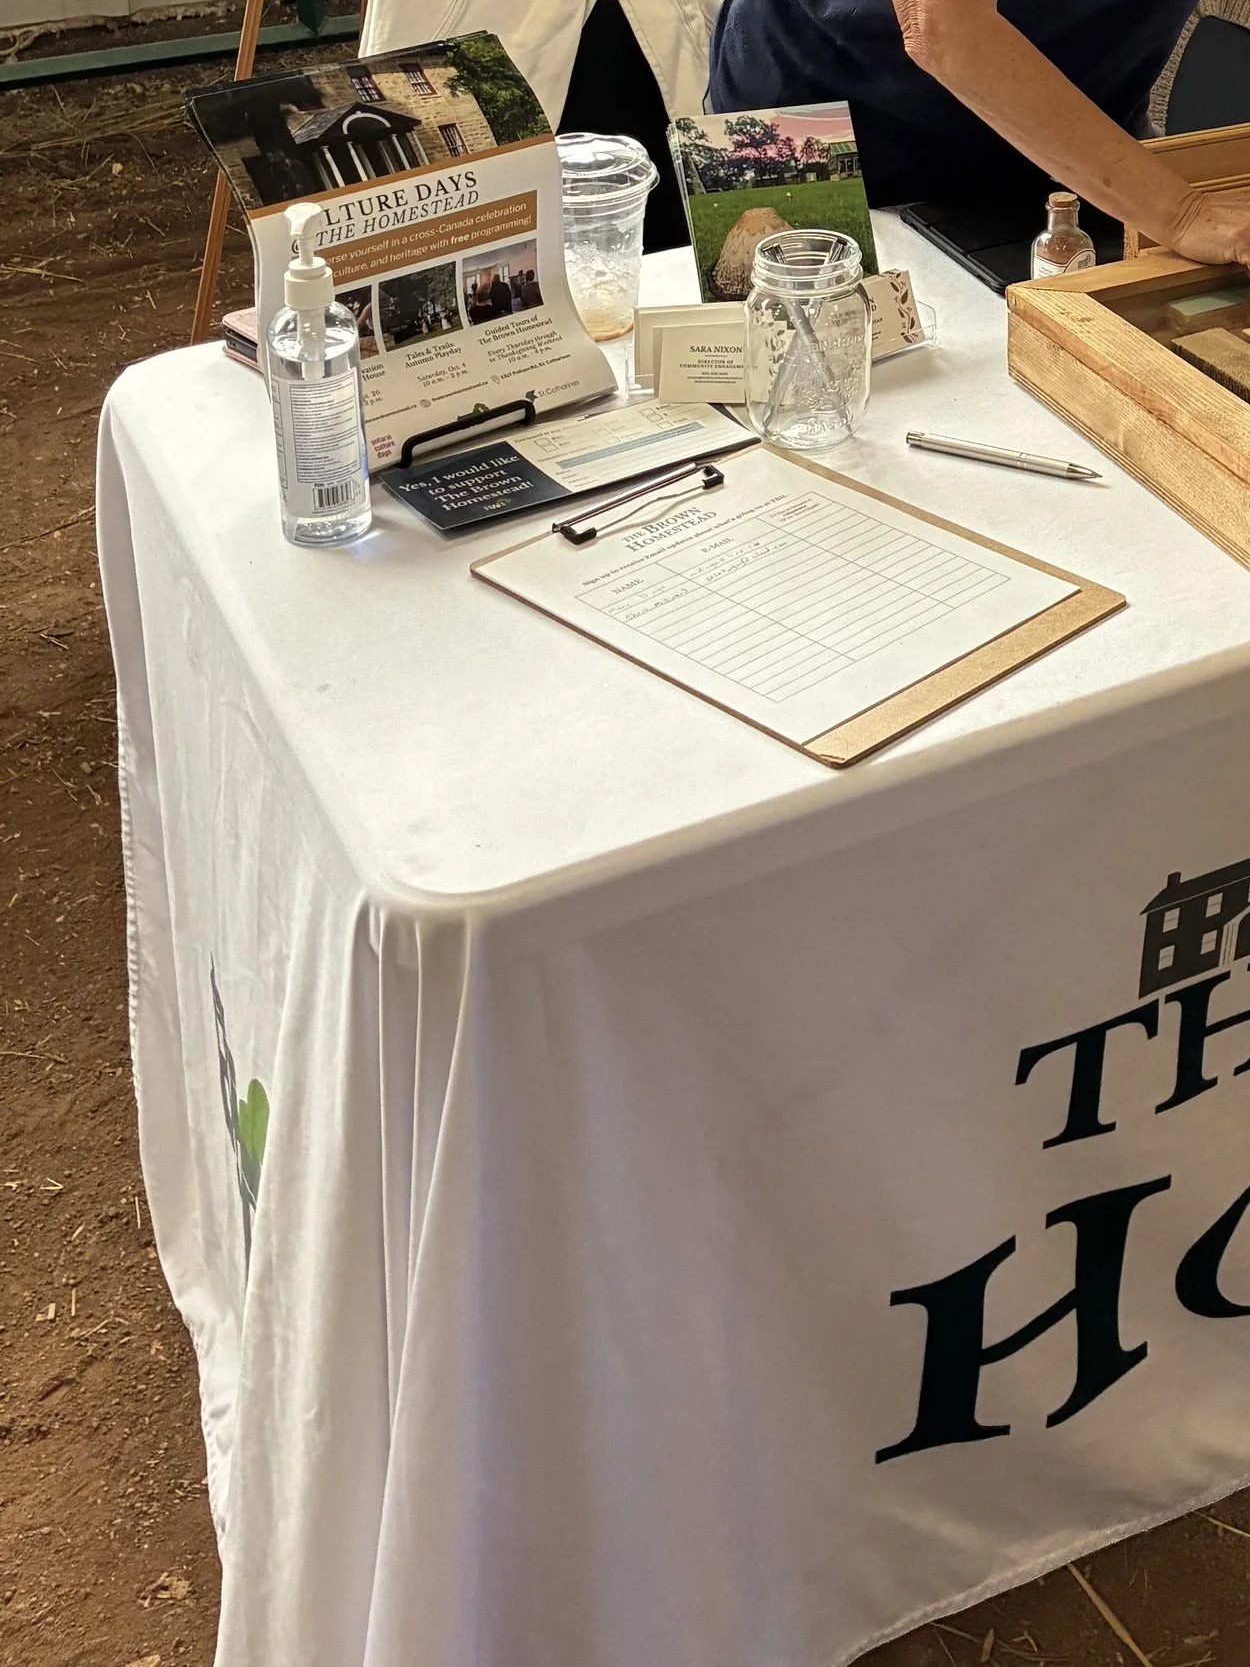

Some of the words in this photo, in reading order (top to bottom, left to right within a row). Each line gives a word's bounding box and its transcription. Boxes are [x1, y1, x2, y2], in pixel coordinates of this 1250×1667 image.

[416, 170, 478, 202] DAYS
[316, 224, 356, 247] THE
[363, 190, 480, 234] HOMESTEAD
[333, 262, 370, 279] culture,
[370, 257, 388, 269] and
[390, 244, 428, 263] heritage
[429, 239, 450, 252] with
[450, 233, 470, 246] free
[471, 215, 533, 242] programming!
[349, 239, 391, 264] yourself
[391, 237, 400, 249] in
[402, 235, 408, 245] a
[409, 216, 474, 242] cross-Canada
[475, 202, 527, 225] celebration
[477, 337, 493, 346] The
[494, 330, 516, 341] Brown
[516, 318, 553, 334] Homestead
[485, 325, 510, 337] Guided
[511, 319, 531, 330] Tours
[530, 315, 539, 323] of
[404, 355, 434, 368] Autumn
[434, 347, 462, 360] Playday
[405, 350, 424, 361] Tales
[433, 342, 456, 354] Trails:
[690, 345, 712, 354] SARA
[714, 346, 743, 354] NIXON
[399, 482, 431, 493] Yes,
[442, 463, 490, 480] would
[490, 455, 520, 467] like
[428, 486, 445, 495] to
[449, 469, 508, 489] support
[435, 490, 469, 503] The
[470, 476, 522, 494] Brown
[441, 481, 534, 511] Homestead!
[622, 529, 647, 543] THE
[642, 506, 702, 534] BROWN
[624, 511, 717, 553] HOMESTEAD
[701, 537, 735, 554] E-MAIL
[612, 578, 644, 595] NAME
